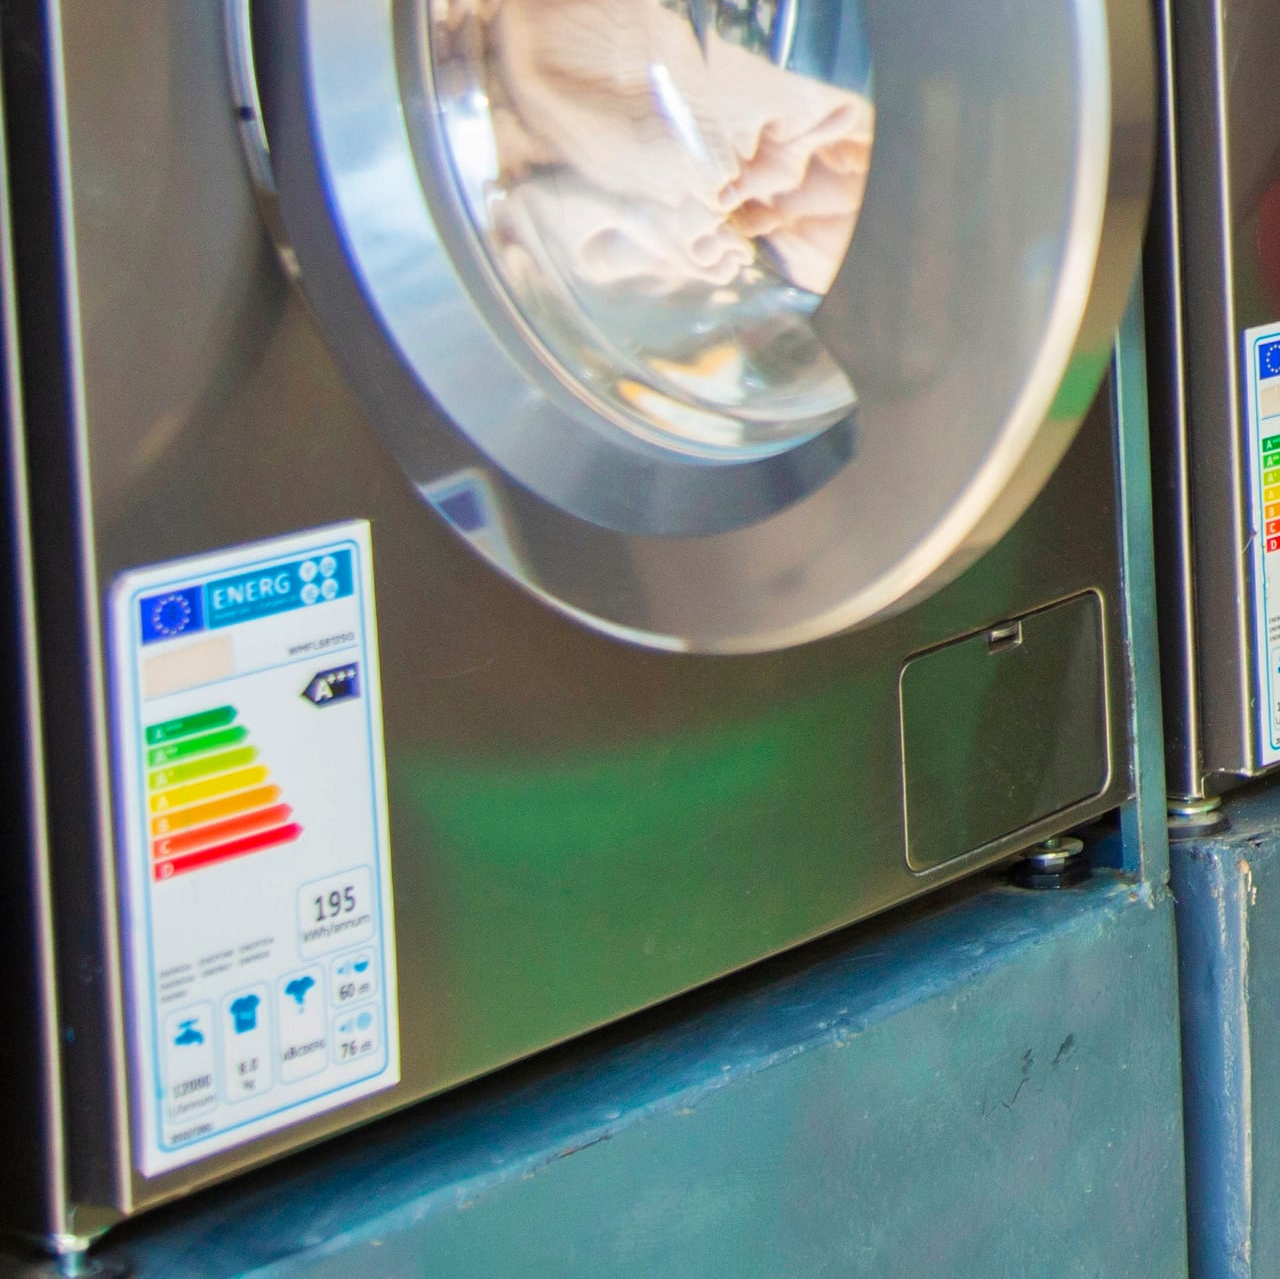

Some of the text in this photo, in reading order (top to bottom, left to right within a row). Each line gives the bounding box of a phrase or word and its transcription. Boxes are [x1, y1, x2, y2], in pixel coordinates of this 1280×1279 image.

[1270, 538, 1278, 550] D
[212, 572, 292, 611] ENERG
[313, 884, 358, 924] 195
